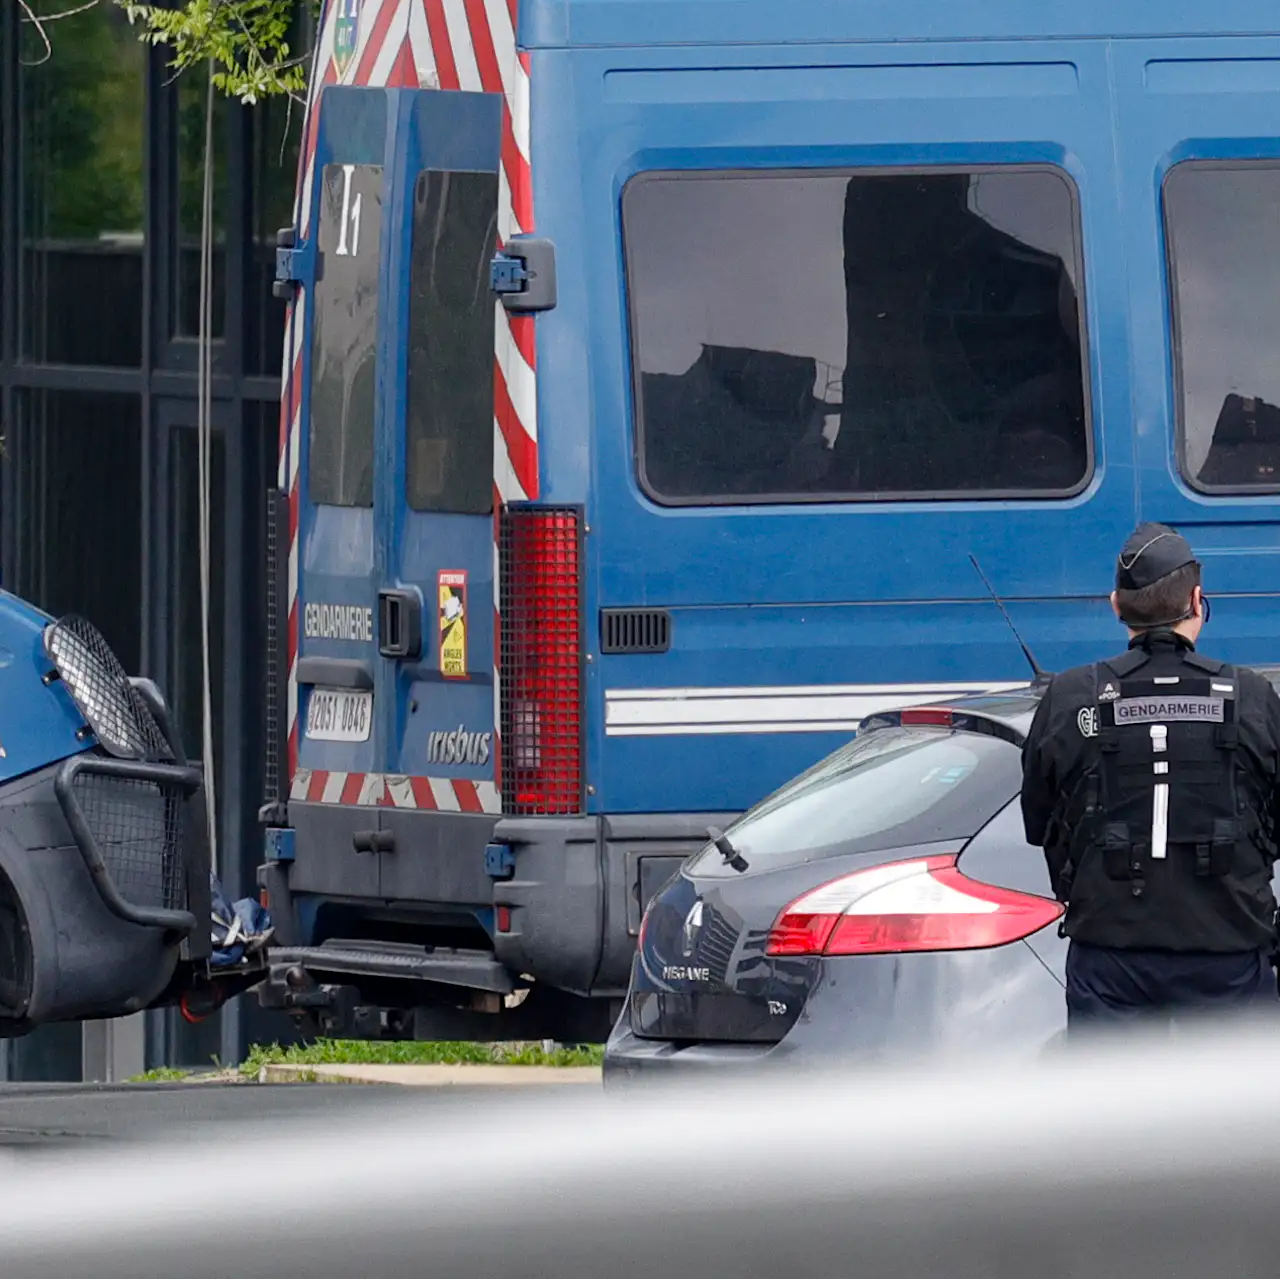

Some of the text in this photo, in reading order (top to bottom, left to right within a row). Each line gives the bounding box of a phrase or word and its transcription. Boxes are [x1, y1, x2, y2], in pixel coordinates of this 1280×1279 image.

[304, 602, 373, 641] GENDARMERIE
[1104, 683, 1113, 691] A
[1119, 703, 1220, 717] GENDARMERIE
